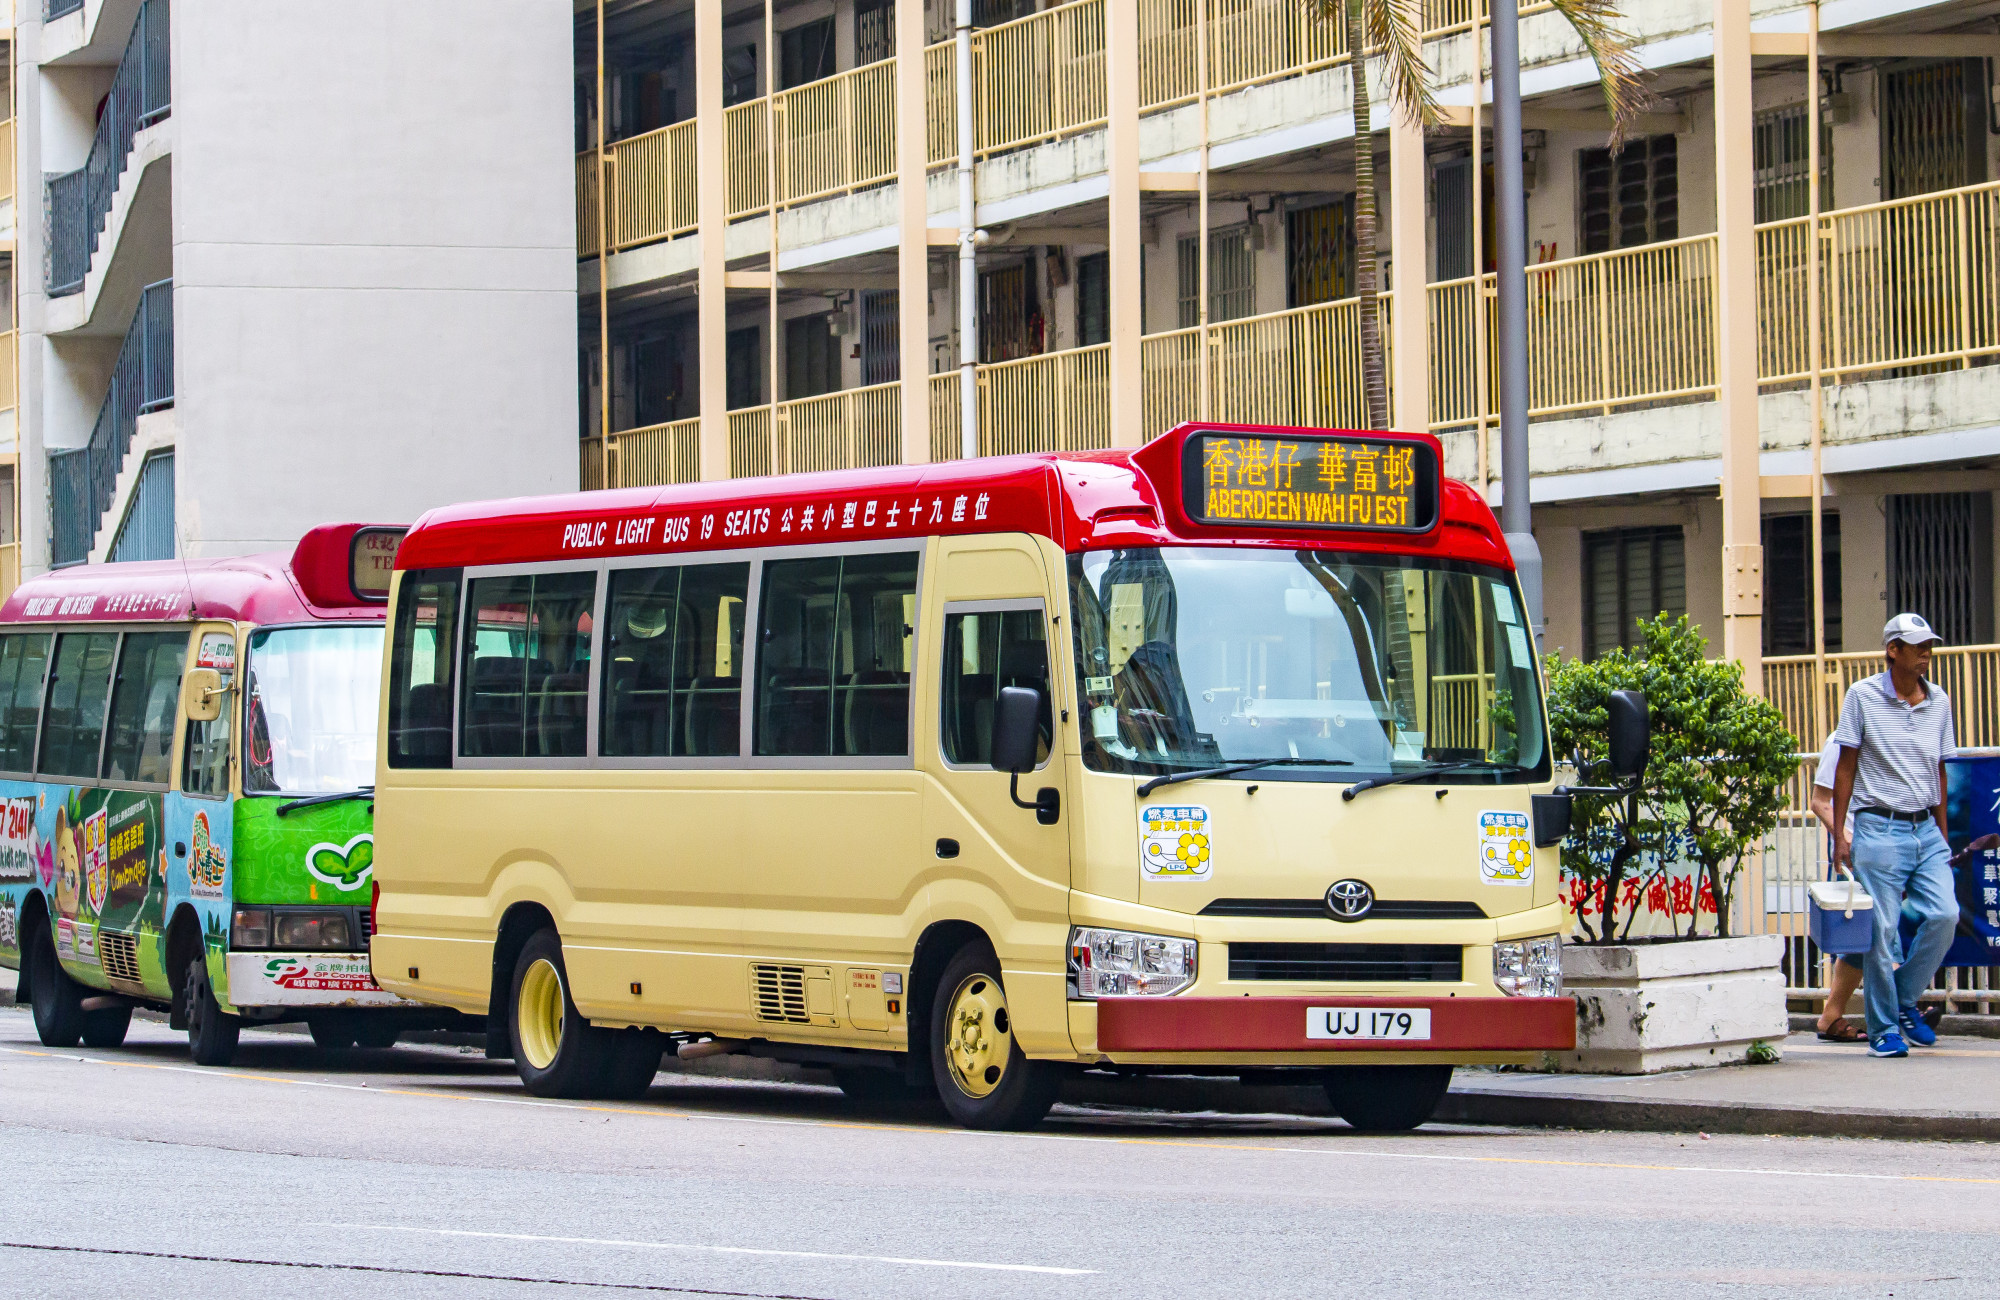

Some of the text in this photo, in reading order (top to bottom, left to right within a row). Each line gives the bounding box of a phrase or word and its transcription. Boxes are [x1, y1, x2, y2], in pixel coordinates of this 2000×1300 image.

[1203, 439, 1414, 494] 香港仔 華富邨
[562, 492, 990, 549] PUBLIC LIGHT BUS 19 SEATS 公共小型巴士十九座位
[1207, 489, 1409, 526] ABERDEEN WAH FU EST
[372, 555, 396, 570] TE
[8, 804, 28, 841] 2141
[1147, 808, 1204, 820] 燃氣車輛
[110, 859, 147, 892] Cambridge
[190, 849, 225, 884] 小博士
[1983, 864, 2000, 883] 華
[1983, 887, 2000, 906] 聚
[1986, 909, 2000, 928] 電
[1326, 1012, 1412, 1035] UJ 179
